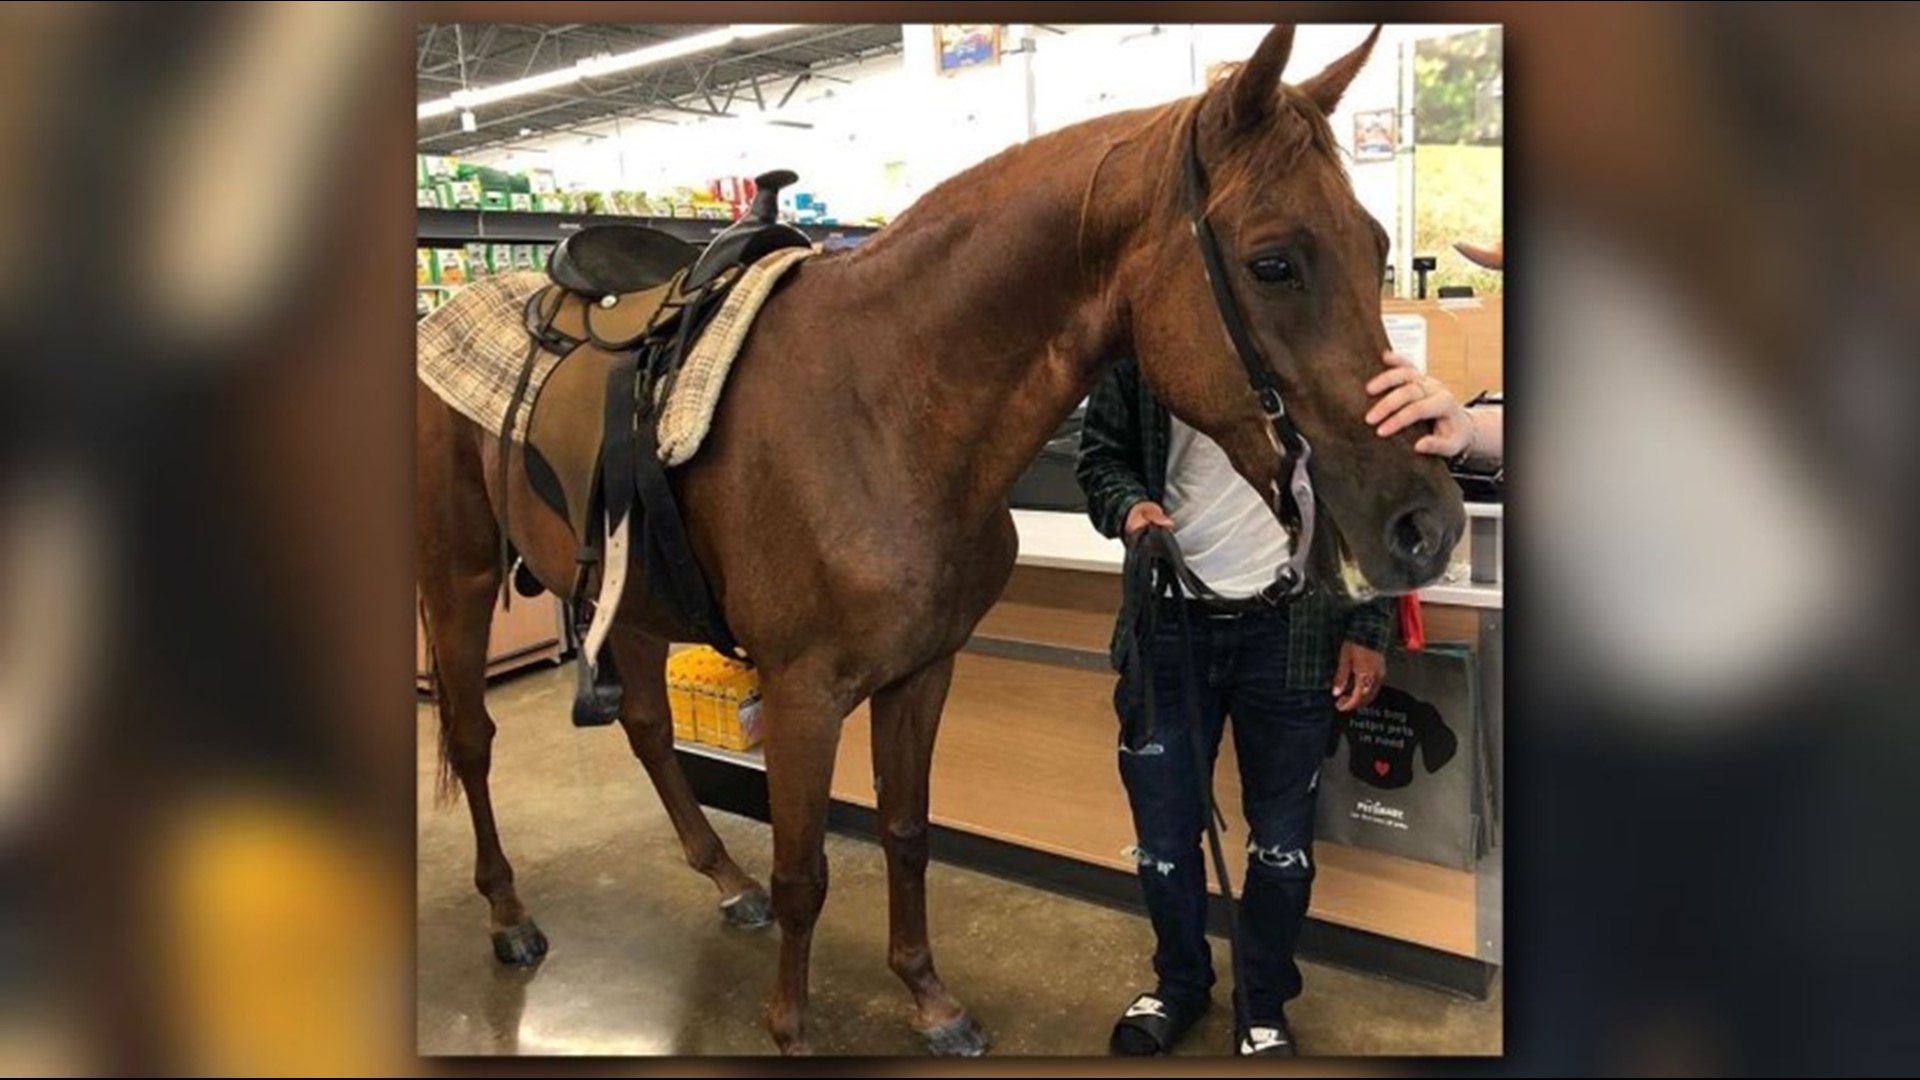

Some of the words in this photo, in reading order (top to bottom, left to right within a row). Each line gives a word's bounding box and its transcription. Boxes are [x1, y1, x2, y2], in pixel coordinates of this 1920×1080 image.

[1349, 718, 1385, 732] helps
[1387, 724, 1414, 737] pets
[1359, 733, 1372, 743] in
[1375, 736, 1405, 749] need
